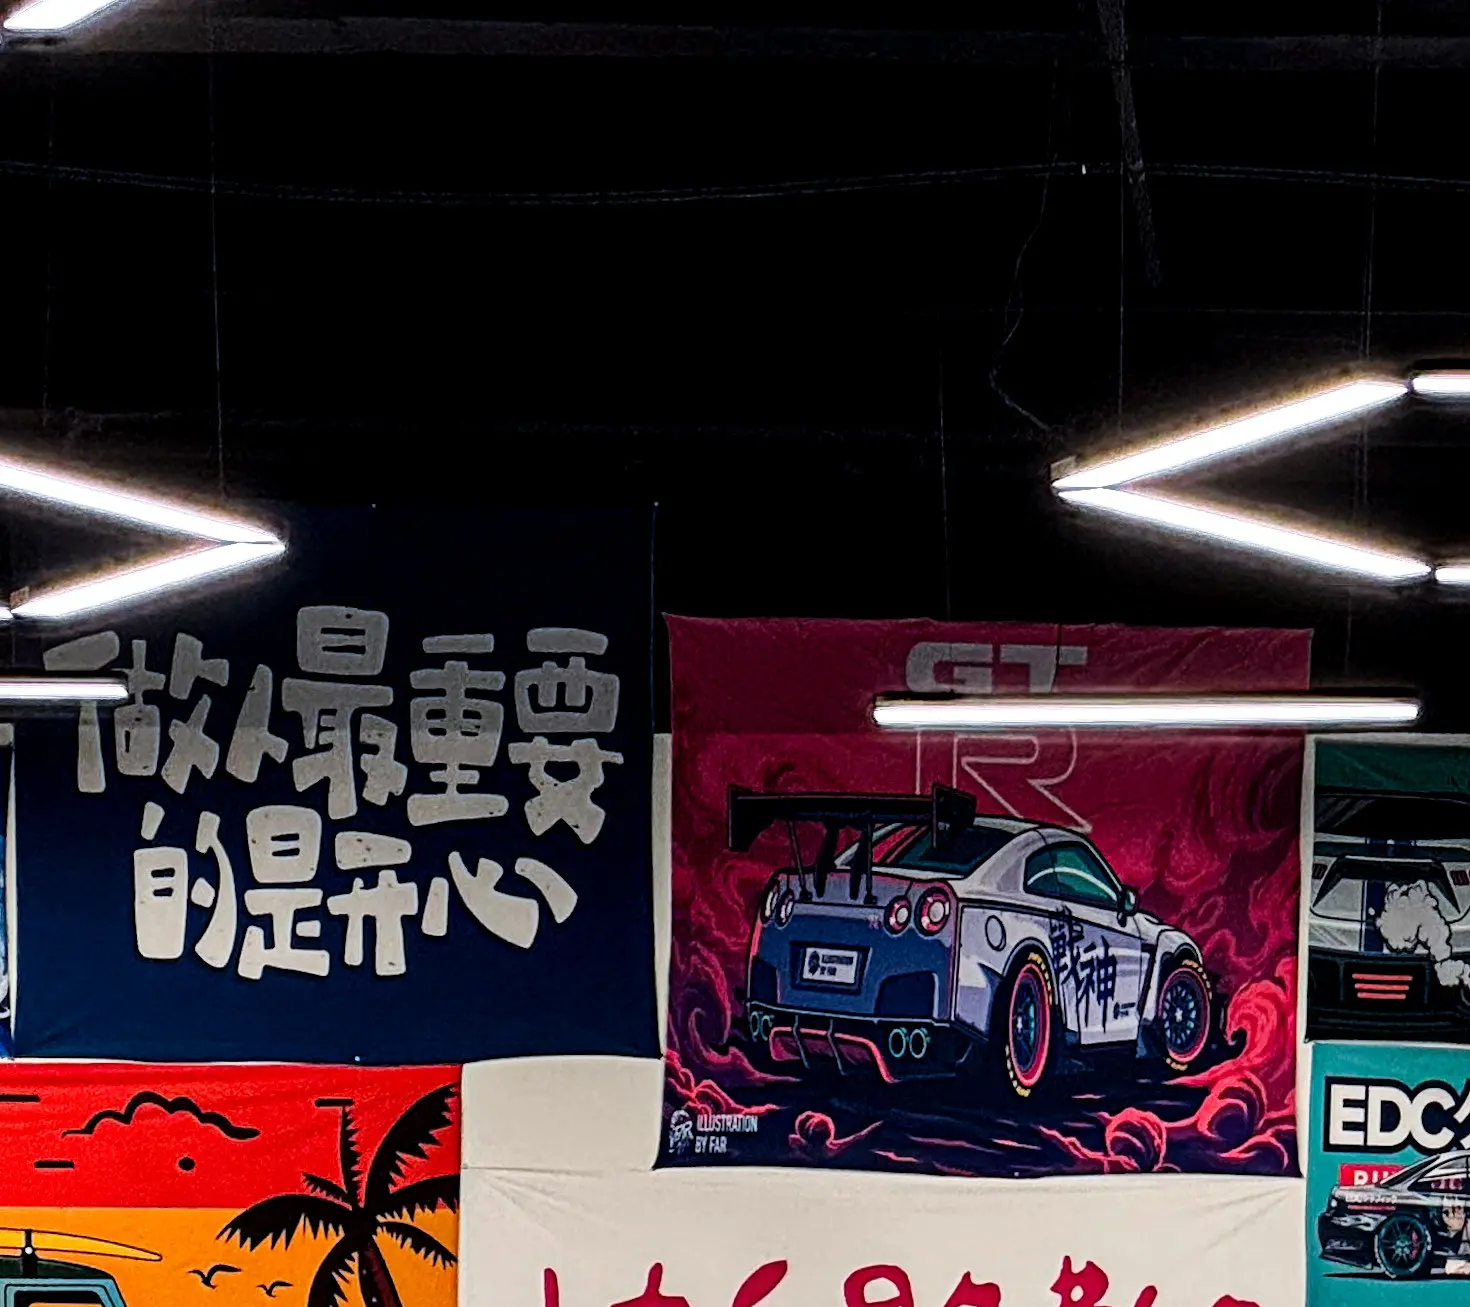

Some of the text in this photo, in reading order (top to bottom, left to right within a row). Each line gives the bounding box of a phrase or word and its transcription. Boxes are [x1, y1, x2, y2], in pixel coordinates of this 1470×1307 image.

[133, 802, 578, 980] 的是开心
[696, 1112, 758, 1132] ILLUSTRATION
